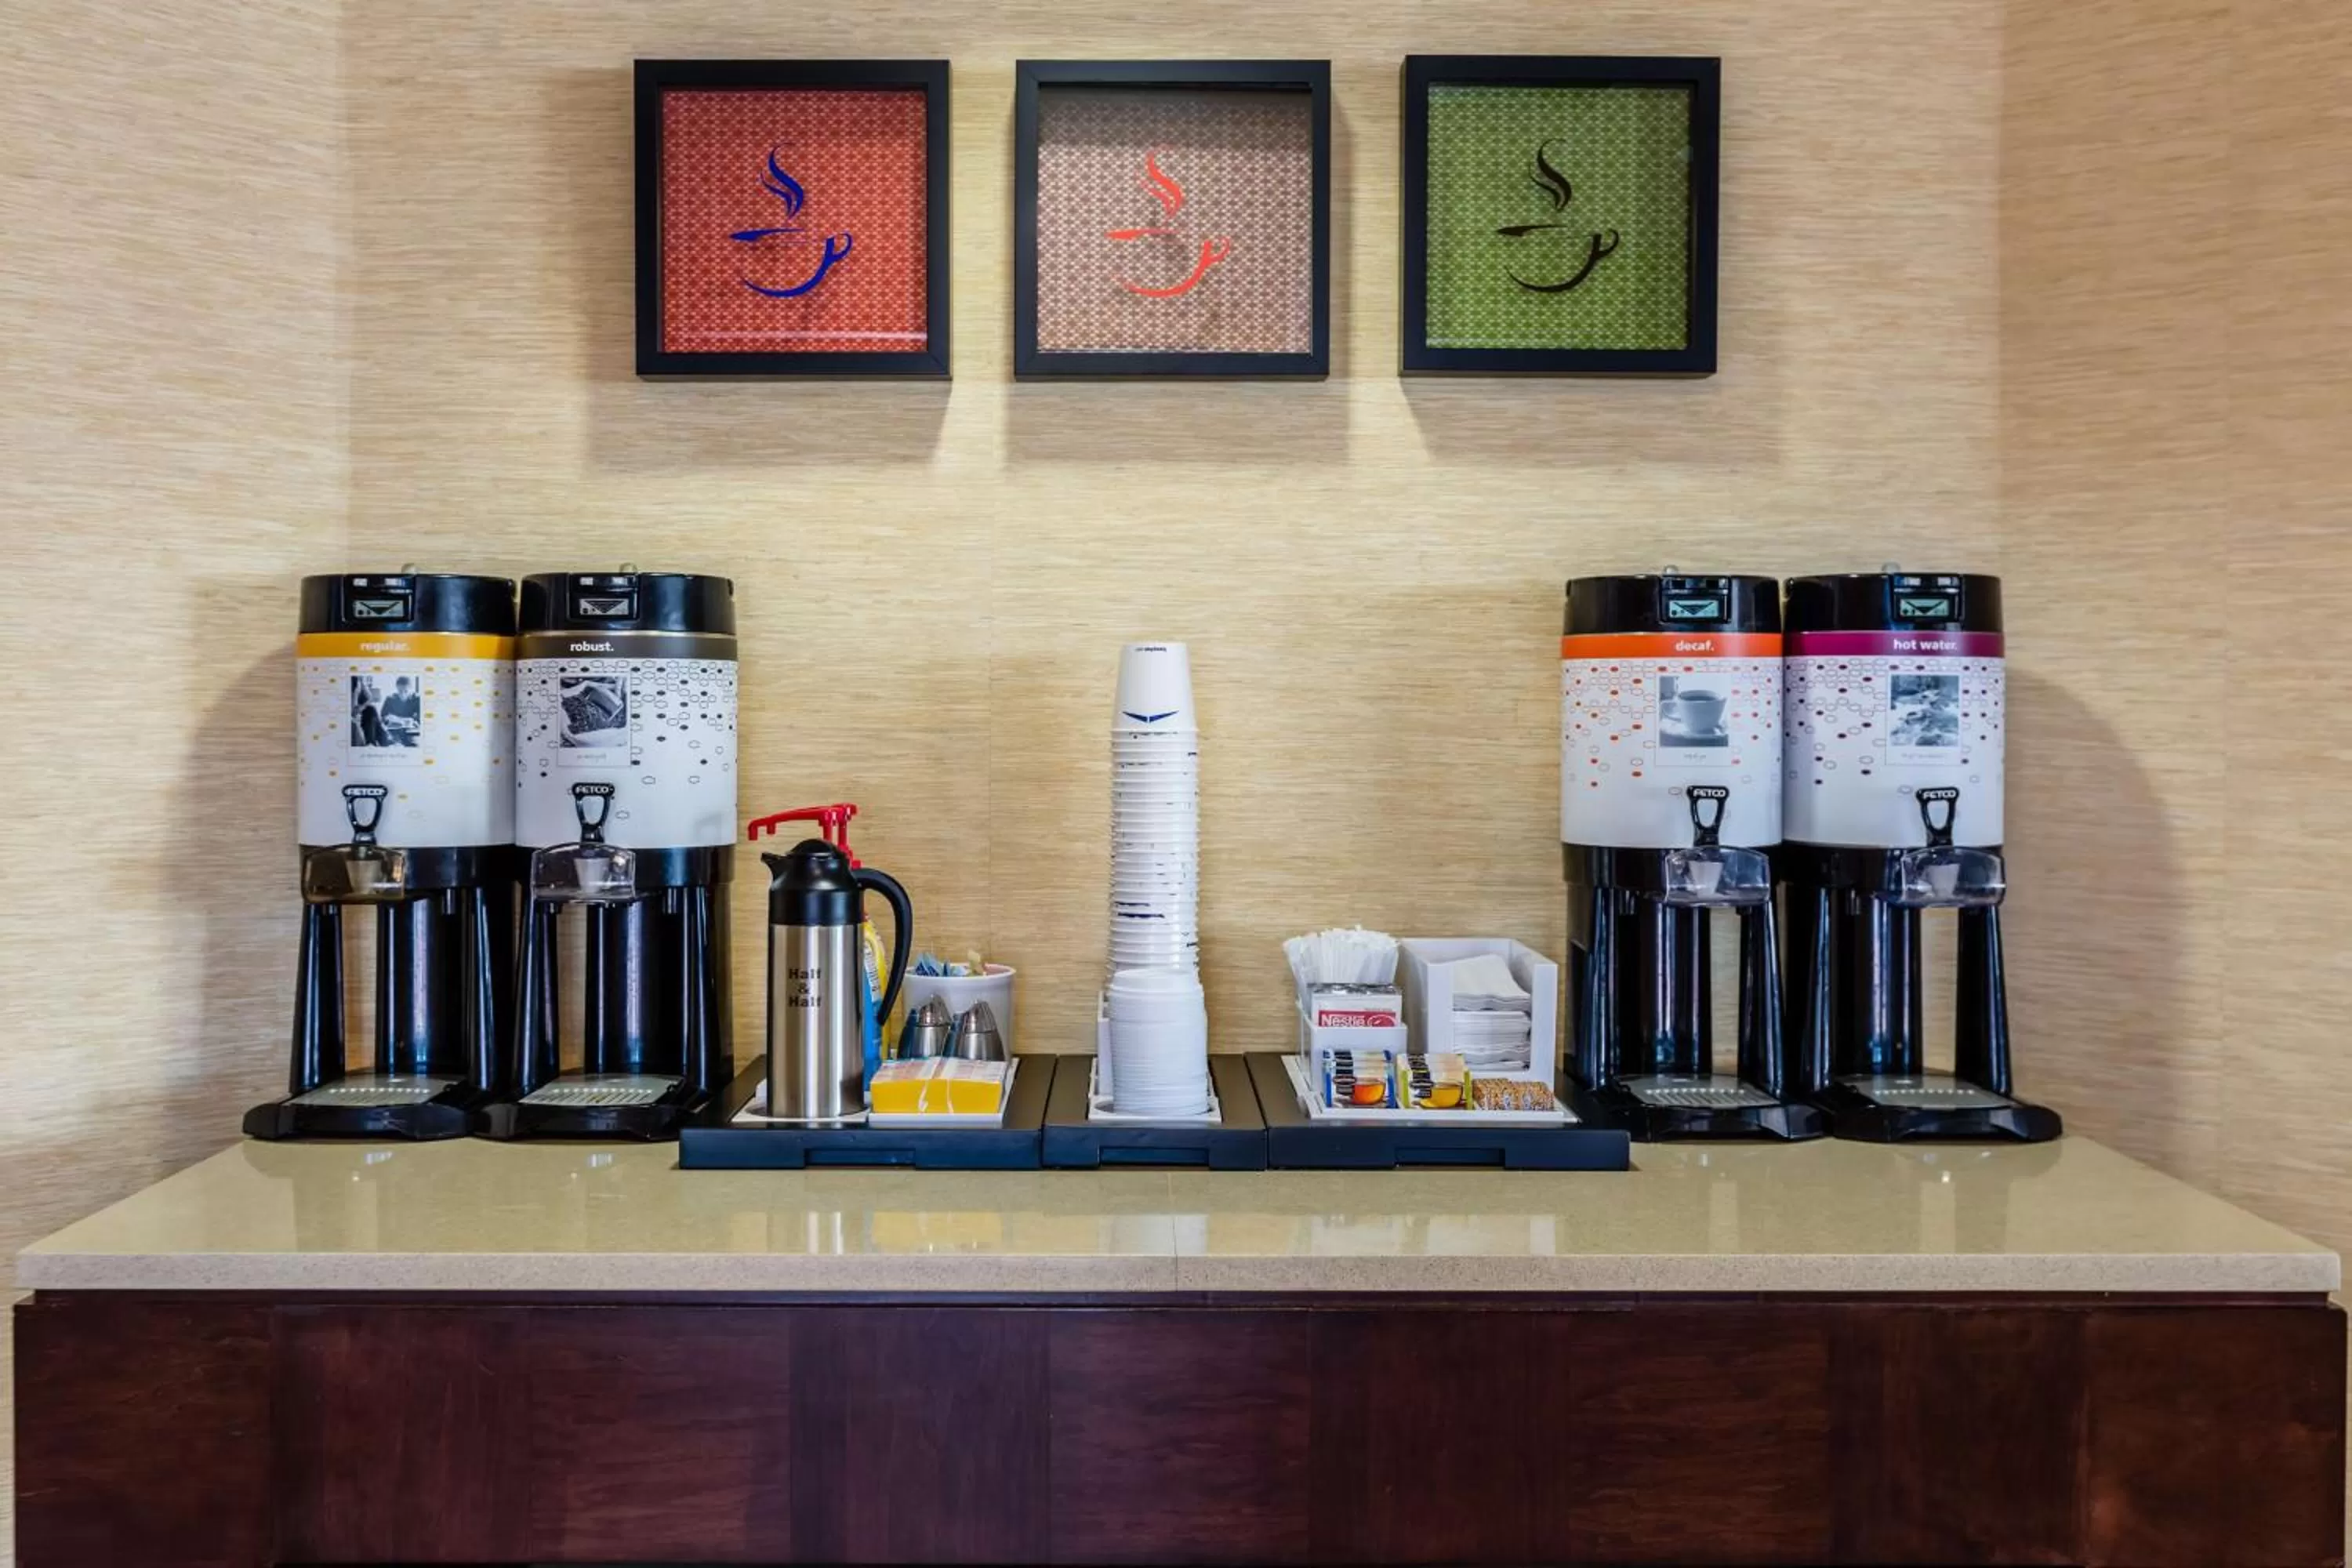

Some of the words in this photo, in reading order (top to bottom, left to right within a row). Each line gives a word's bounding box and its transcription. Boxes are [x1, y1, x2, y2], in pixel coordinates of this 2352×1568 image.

[570, 641, 615, 652] robust.
[1675, 640, 1715, 652] decaf.
[1893, 639, 1917, 650] hot
[1693, 788, 1726, 797] FETCO
[1923, 789, 1957, 800] FETCO
[788, 968, 822, 979] Half
[797, 982, 809, 994] &
[788, 996, 822, 1007] Half
